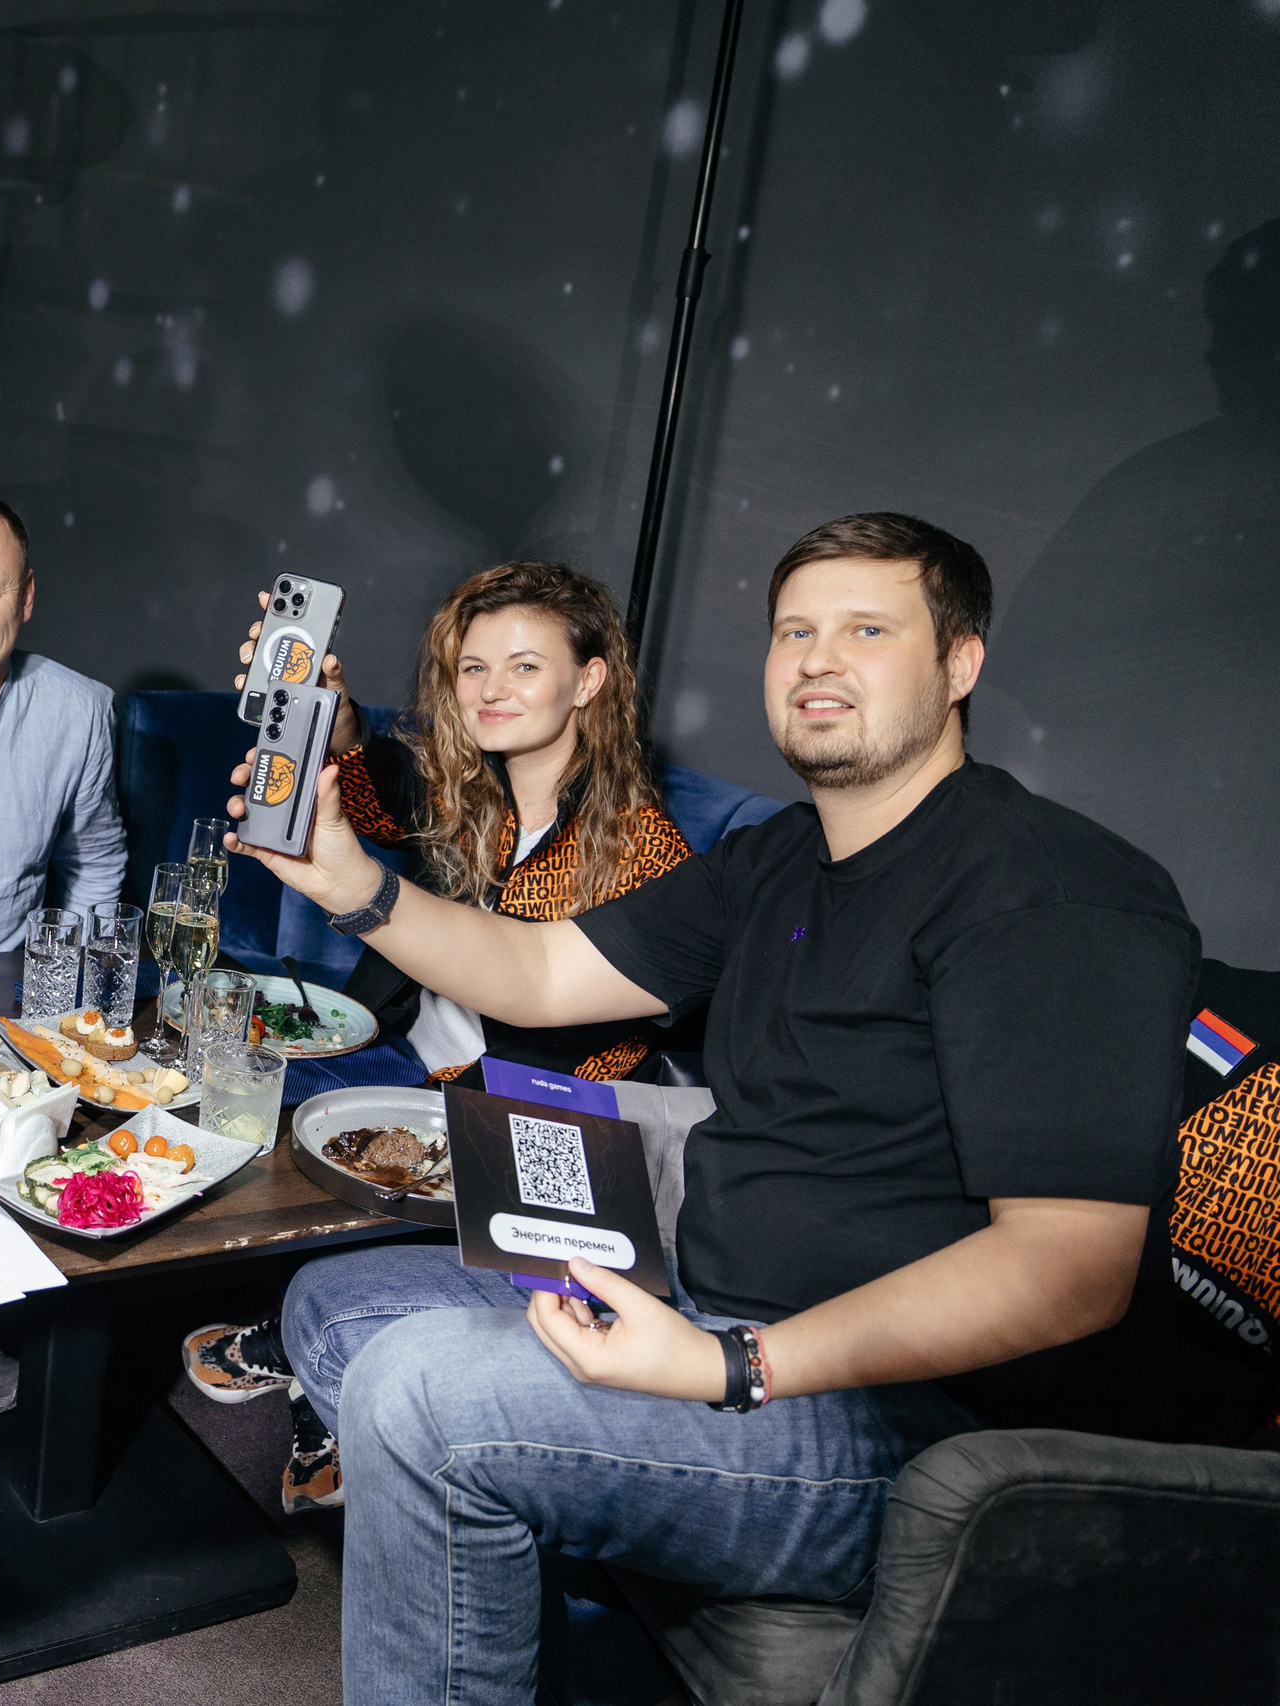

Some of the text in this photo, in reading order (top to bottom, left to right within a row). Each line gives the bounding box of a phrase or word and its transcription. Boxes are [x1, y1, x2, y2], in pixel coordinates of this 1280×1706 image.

[253, 754, 270, 801] EQUIUM
[548, 1081, 572, 1093] games
[511, 1226, 616, 1253] Энергия перемен
